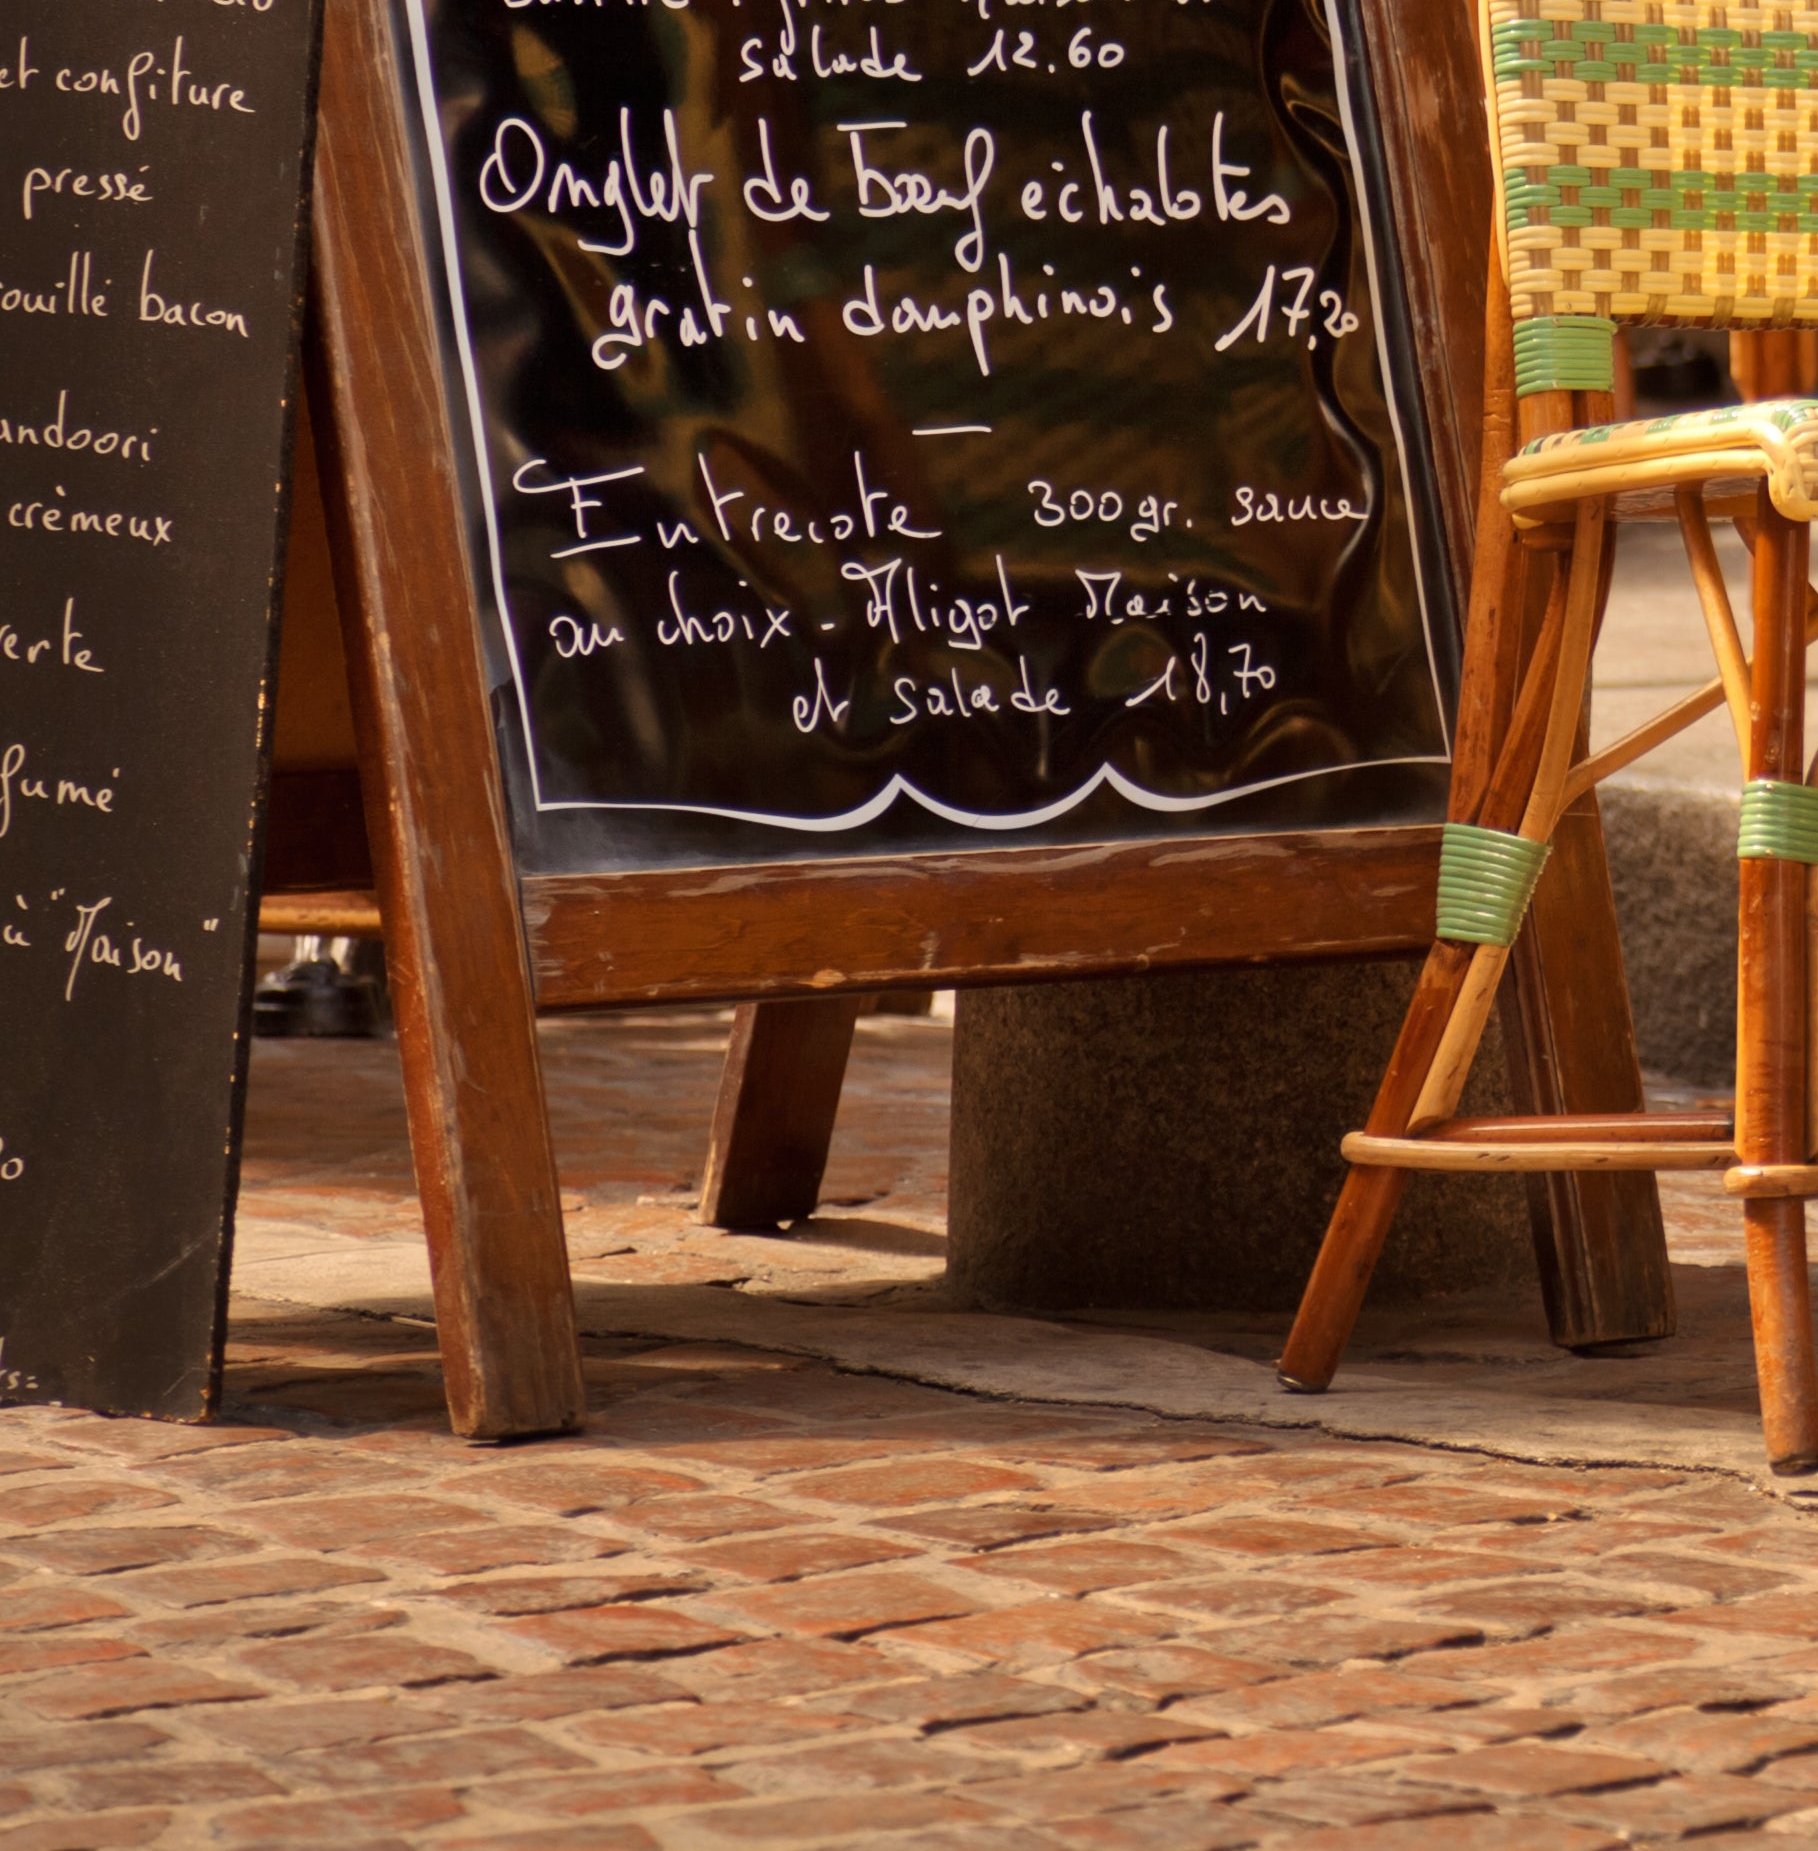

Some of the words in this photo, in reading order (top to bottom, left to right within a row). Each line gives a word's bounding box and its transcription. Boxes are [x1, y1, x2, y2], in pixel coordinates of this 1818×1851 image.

[56, 35, 256, 141] confiture
[739, 24, 922, 83] salade
[23, 165, 153, 219] pressé
[479, 107, 714, 256] Onglet
[743, 118, 830, 222] de
[0, 249, 112, 316] ouillé
[139, 249, 249, 338] bacon
[591, 229, 805, 370] gratin
[842, 252, 1173, 376] dauphinois
[1231, 486, 1369, 526] sauce
[549, 616, 625, 658] au
[657, 570, 790, 648] choix
[1075, 569, 1266, 625] Maison
[792, 658, 849, 733] et
[890, 655, 1070, 724] salade
